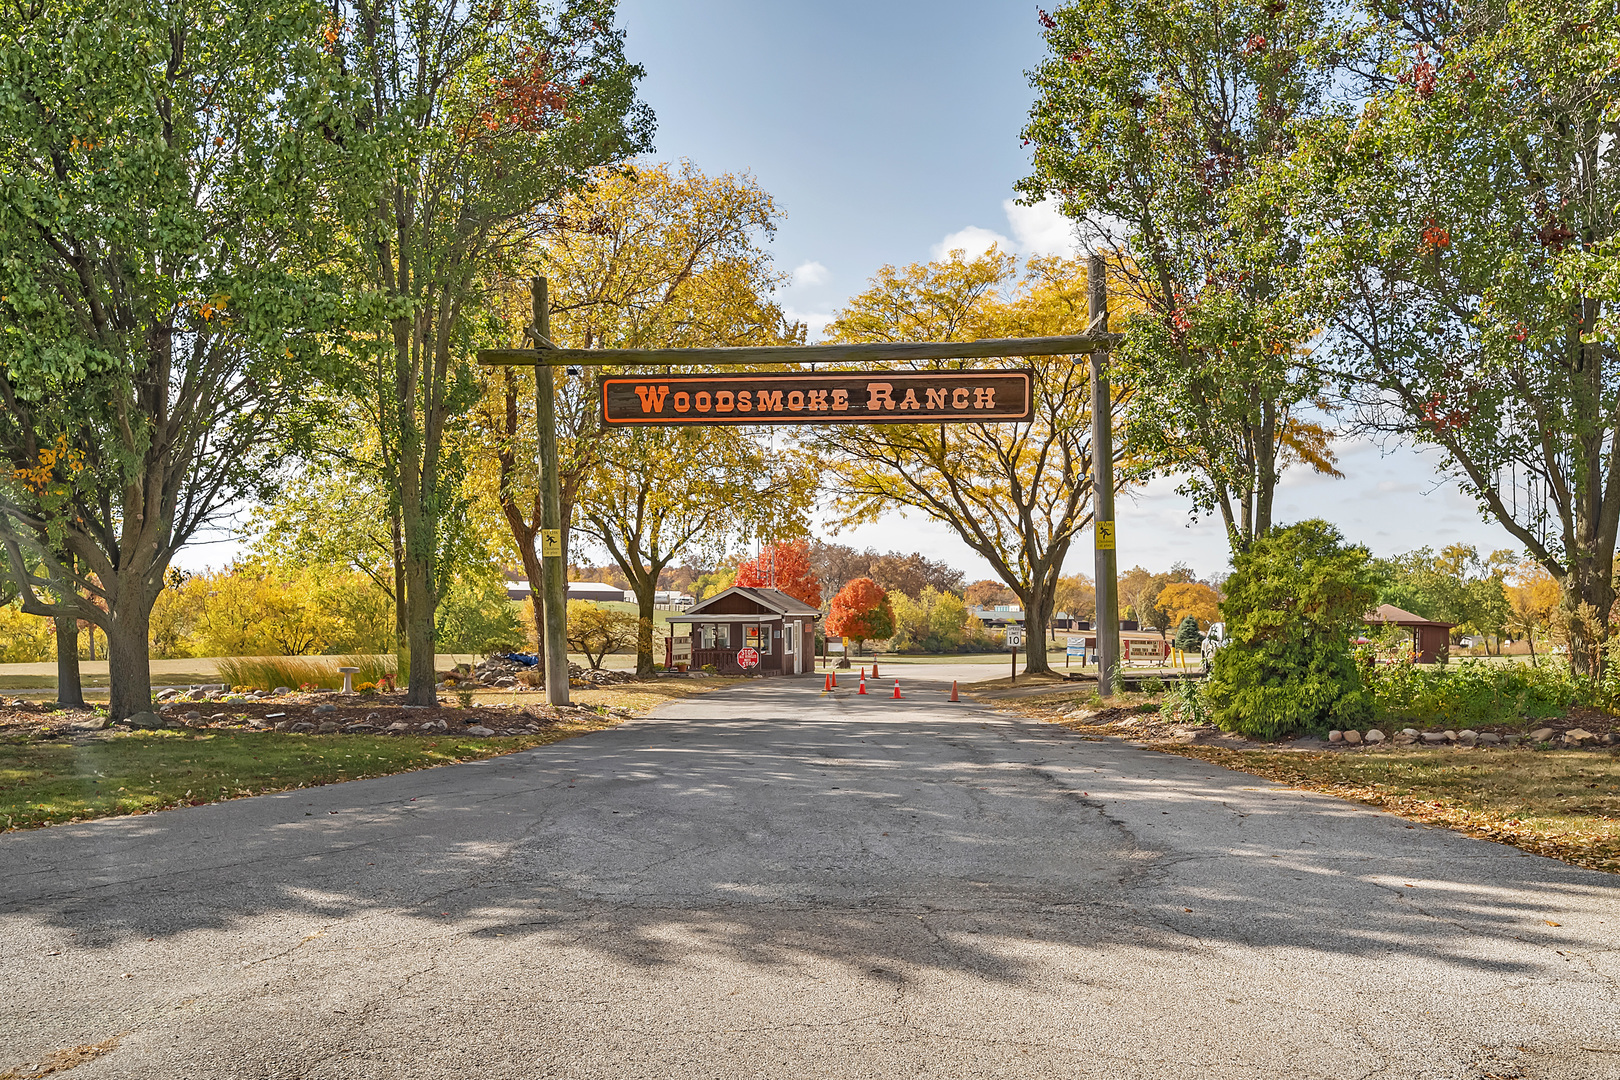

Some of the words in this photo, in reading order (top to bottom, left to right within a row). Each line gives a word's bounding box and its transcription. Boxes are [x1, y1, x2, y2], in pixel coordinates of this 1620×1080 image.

[634, 385, 849, 413] WOODSMOKE
[866, 382, 996, 411] RANCH
[1009, 636, 1020, 644] 10
